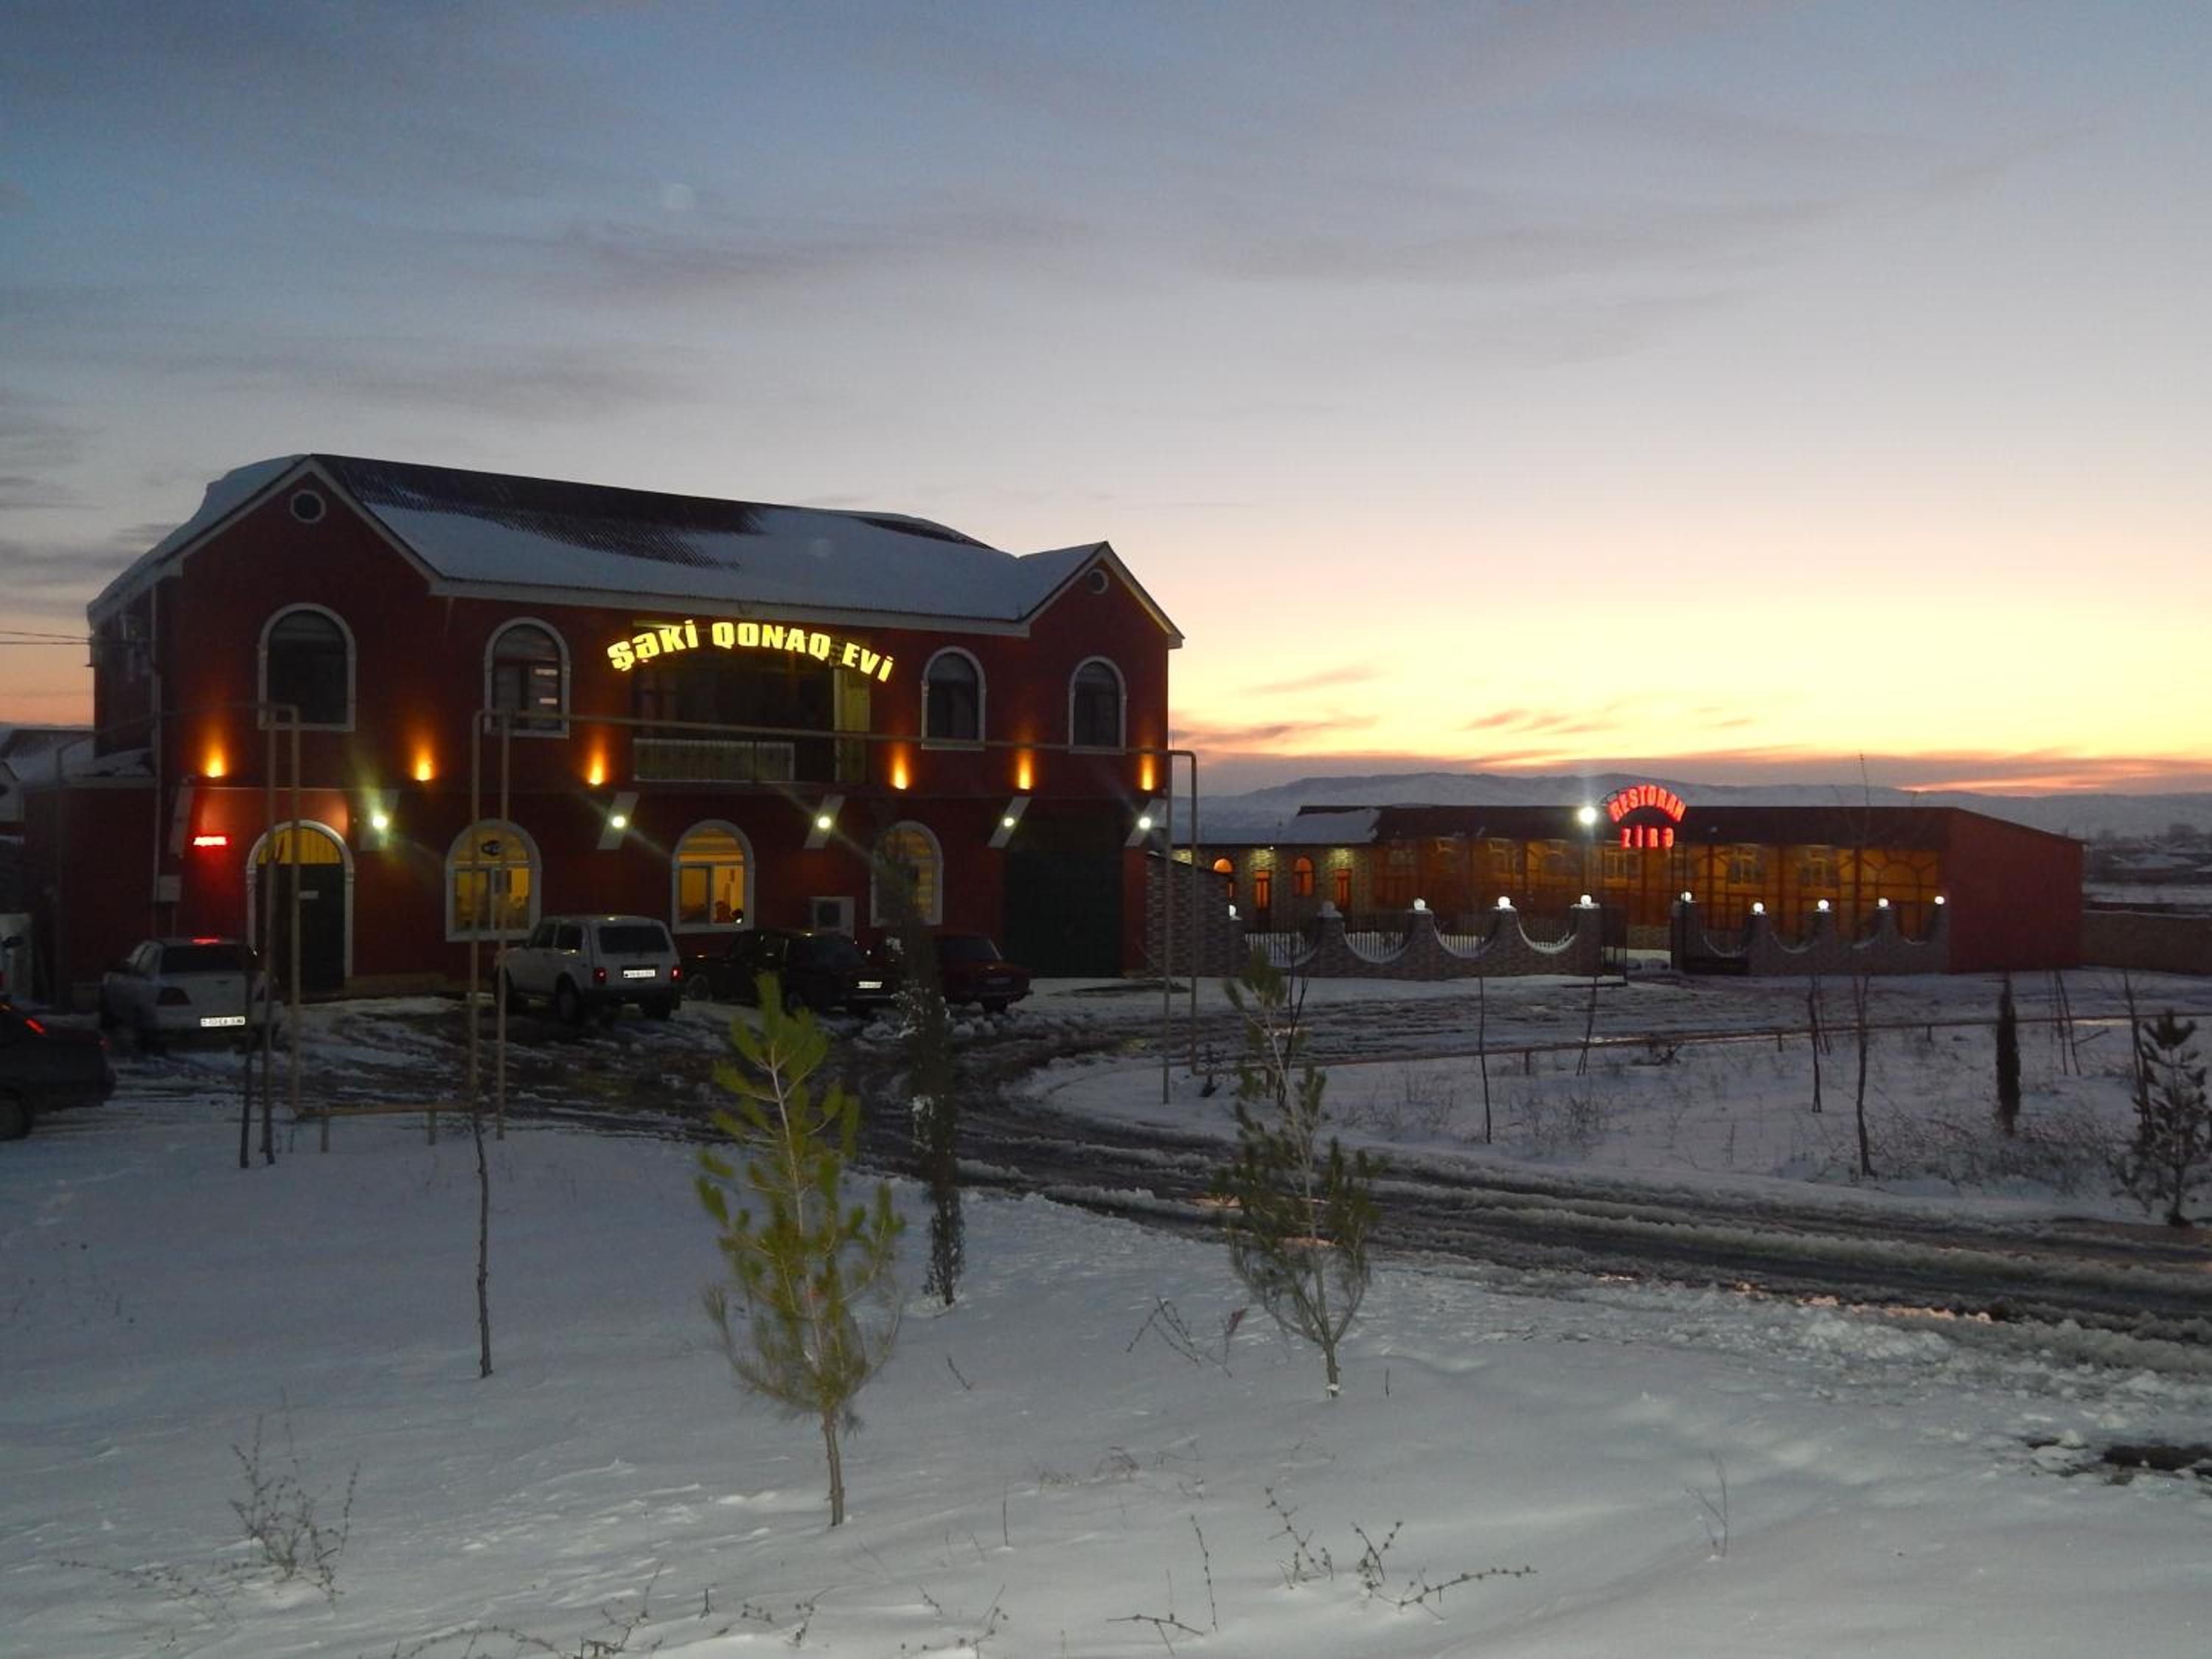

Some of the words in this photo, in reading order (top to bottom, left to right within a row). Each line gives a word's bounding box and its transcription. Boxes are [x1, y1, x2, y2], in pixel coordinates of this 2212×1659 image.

[712, 622, 832, 661] QONAQ
[841, 642, 894, 683] EVİ
[1608, 784, 1686, 822] RESTORAN
